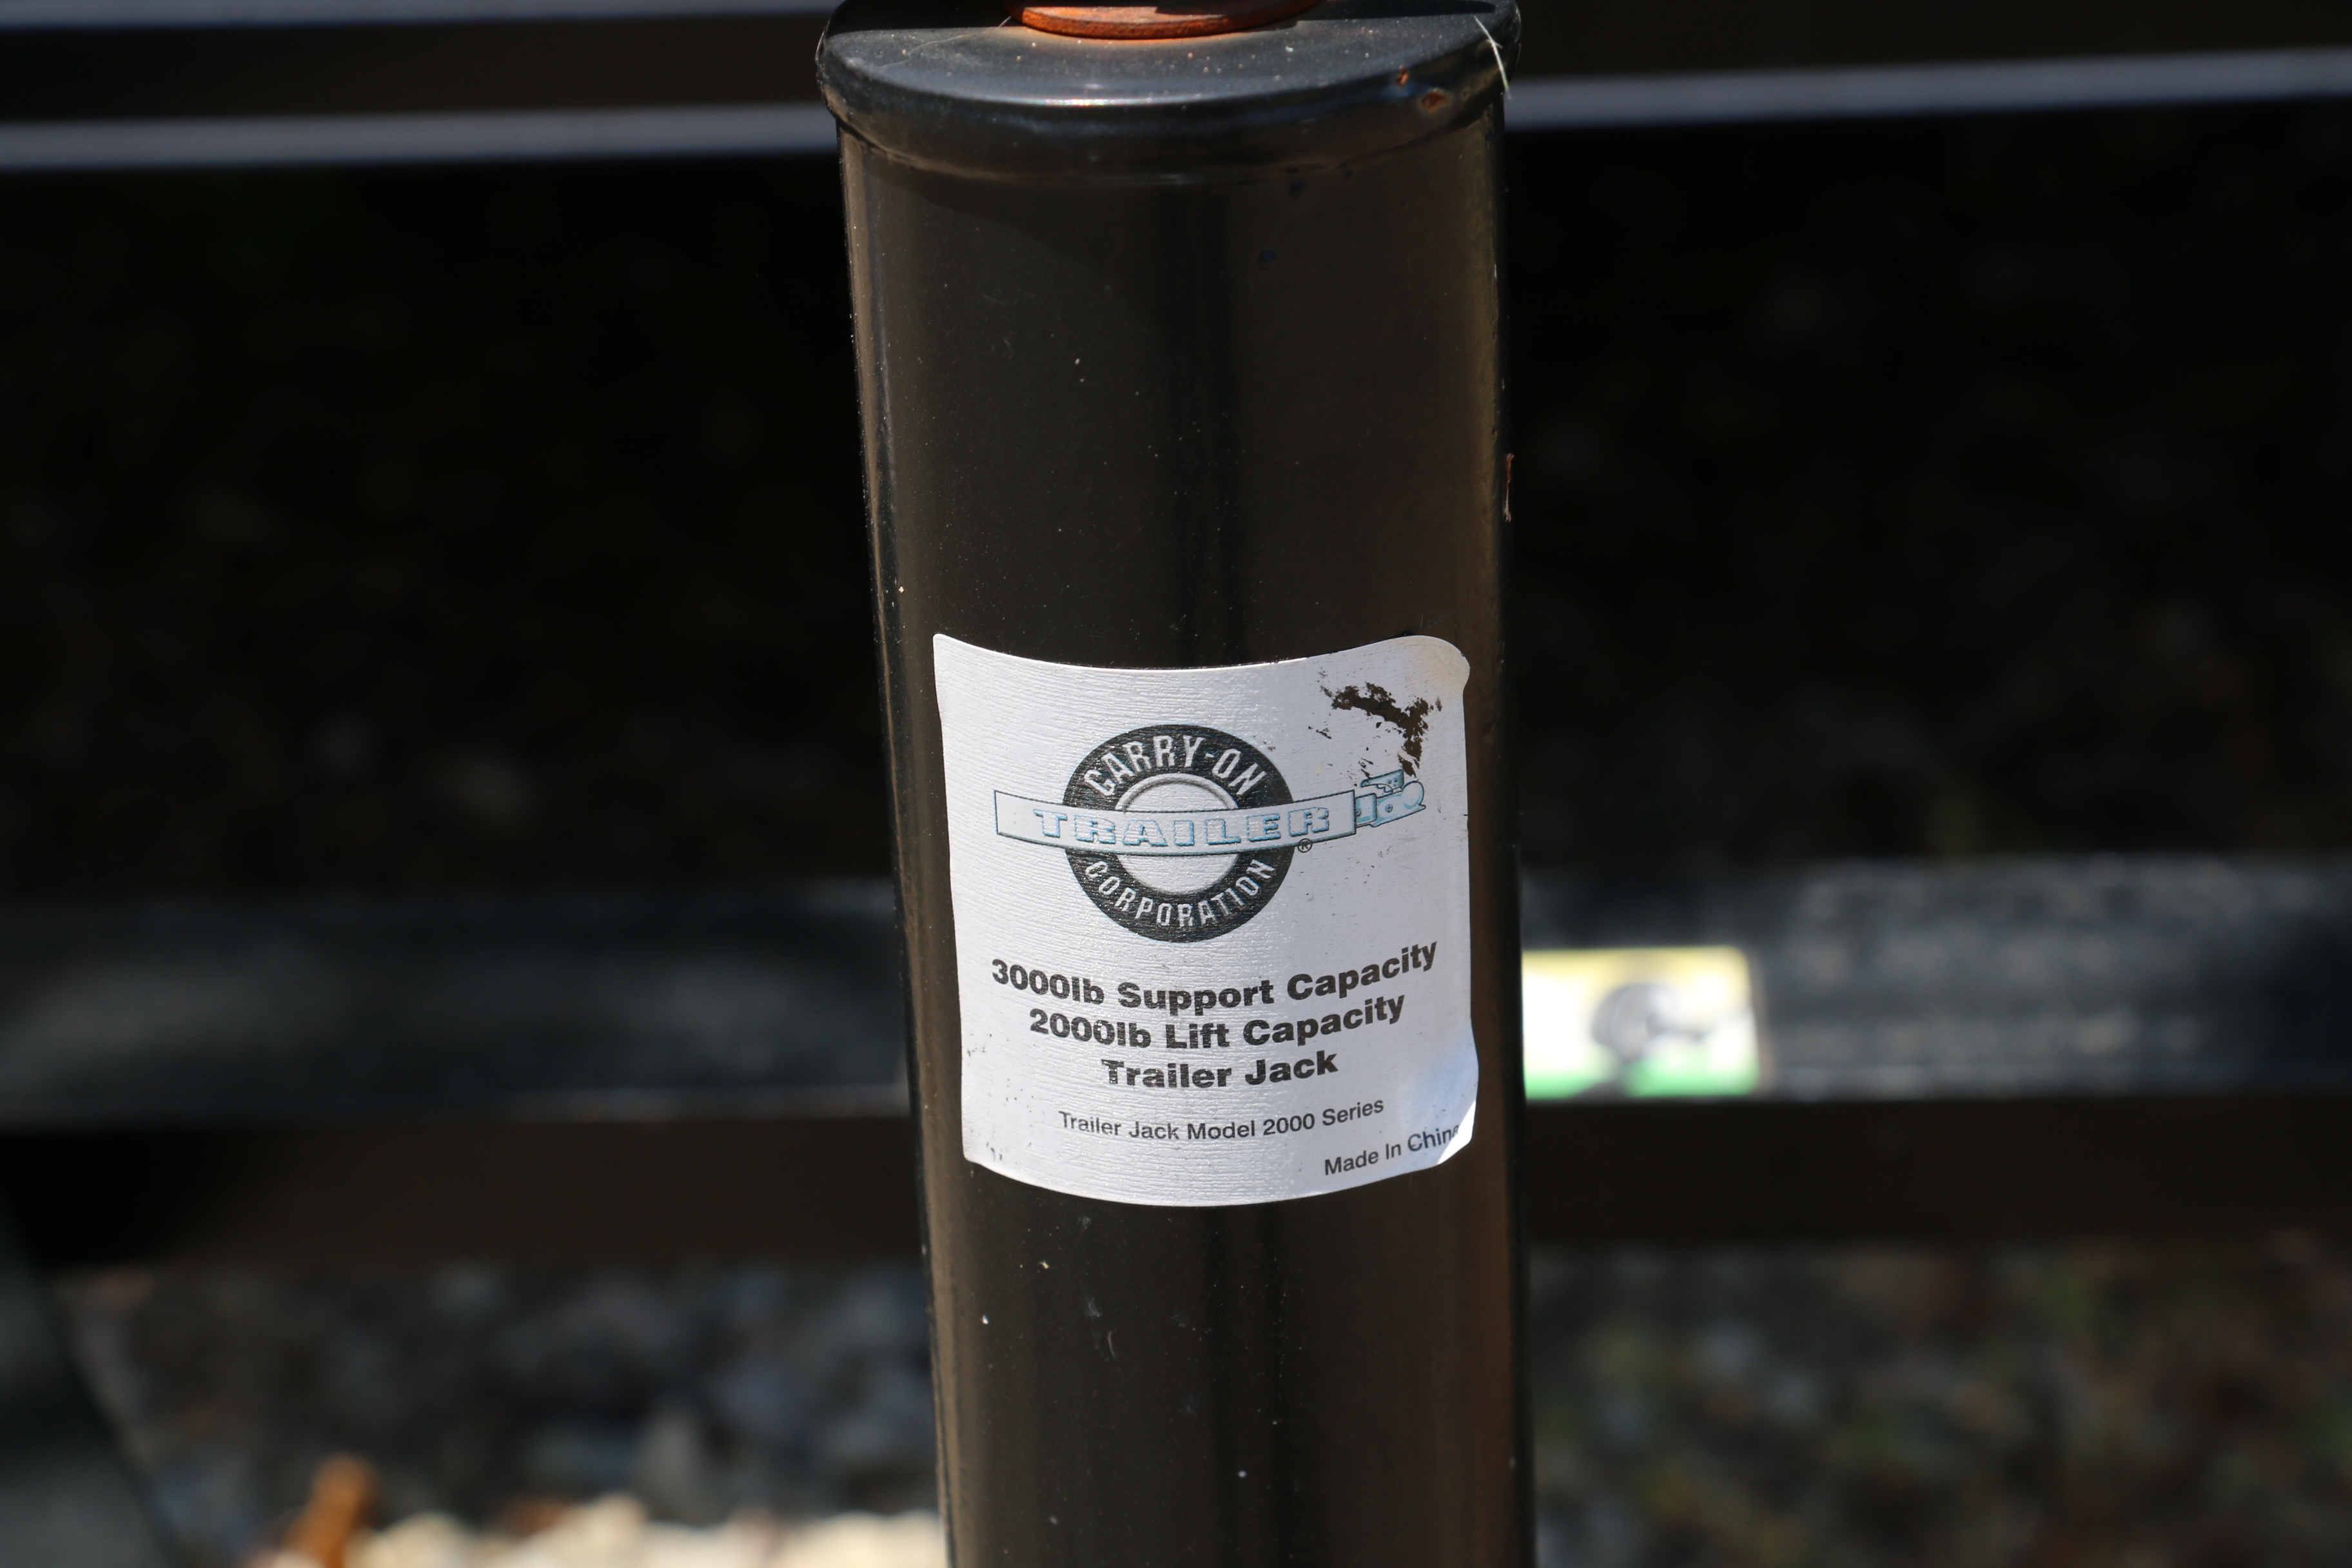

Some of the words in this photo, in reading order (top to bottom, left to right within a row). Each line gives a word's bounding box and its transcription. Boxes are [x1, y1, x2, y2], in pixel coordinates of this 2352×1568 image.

[1084, 734, 1266, 798] CARRY-ON
[1033, 807, 1330, 847] TRAILER
[1086, 858, 1275, 928] CORPORATION
[992, 958, 1105, 1005] 3000lb
[1117, 979, 1275, 1016] Support
[1286, 941, 1438, 1001] Capacity
[1029, 1008, 1152, 1048] 2000lb
[1165, 1023, 1230, 1049] Lift
[1242, 995, 1406, 1046] Capacity
[1101, 1059, 1232, 1088] Trailer
[1244, 1050, 1339, 1086] Jack
[1059, 1110, 1122, 1137] Trailer
[1128, 1121, 1180, 1140] Jack
[1187, 1120, 1256, 1140] Model
[1262, 1113, 1316, 1136] 2000
[1322, 1099, 1384, 1127] Series
[1324, 1152, 1379, 1176] Made
[1384, 1142, 1402, 1161] In
